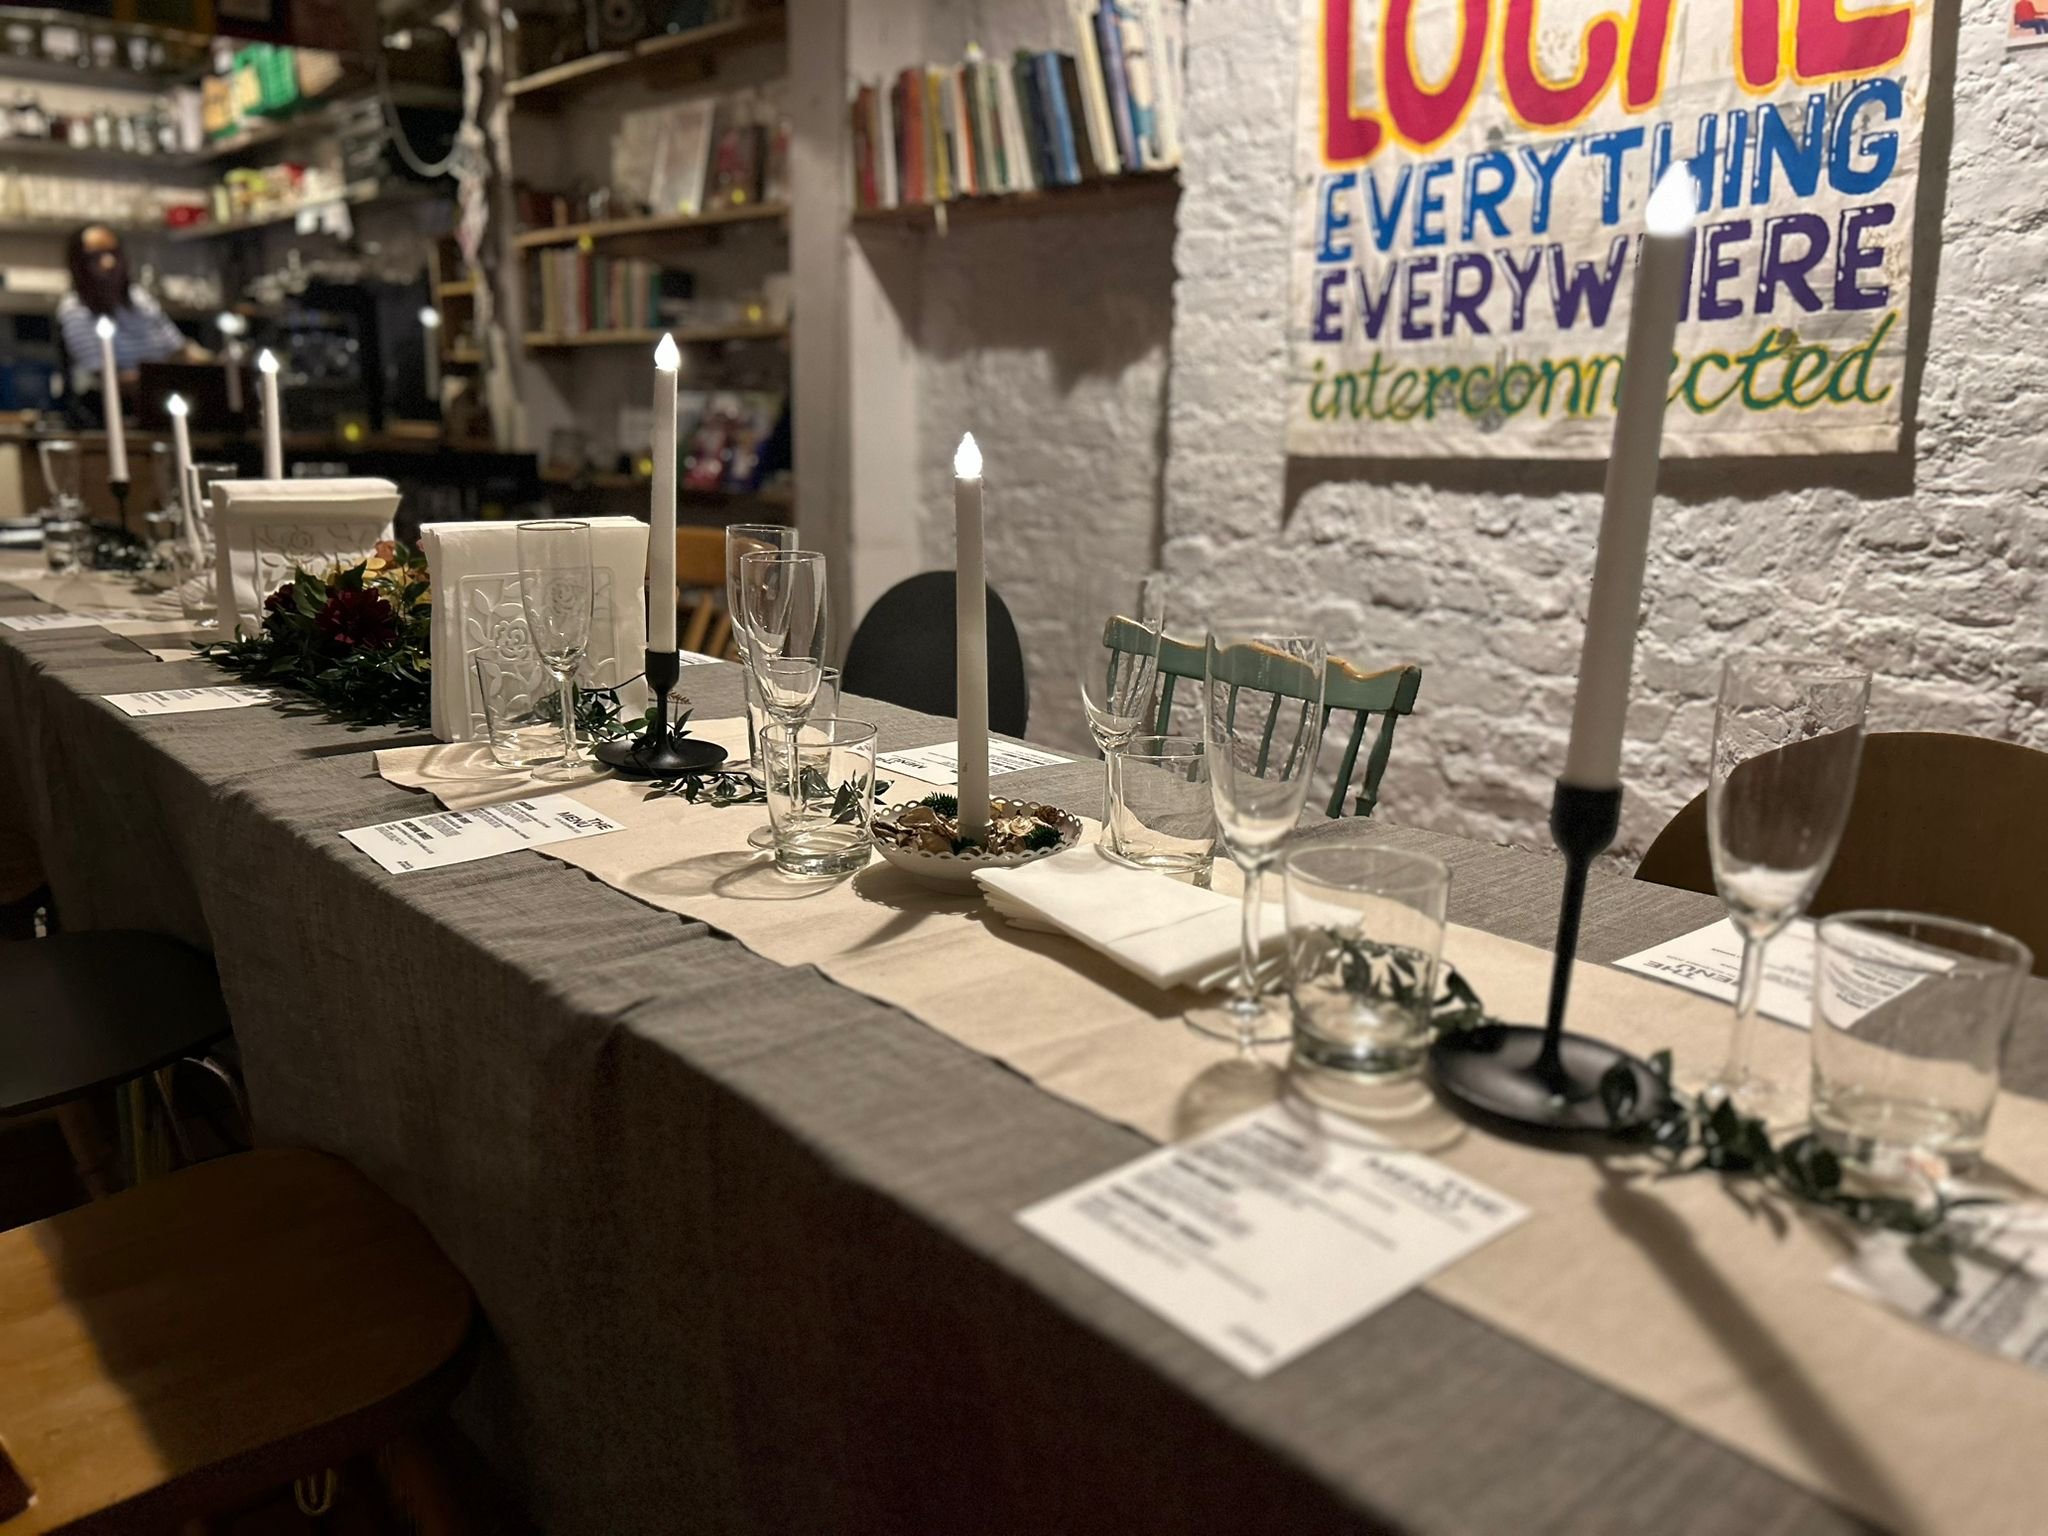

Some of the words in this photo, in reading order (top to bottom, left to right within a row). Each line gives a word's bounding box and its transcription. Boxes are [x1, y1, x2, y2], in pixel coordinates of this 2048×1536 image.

[1315, 77, 1903, 264] EVERYTHING
[1309, 312, 1899, 421] interconncted
[556, 811, 592, 828] MENU
[1642, 960, 1695, 980] THE
